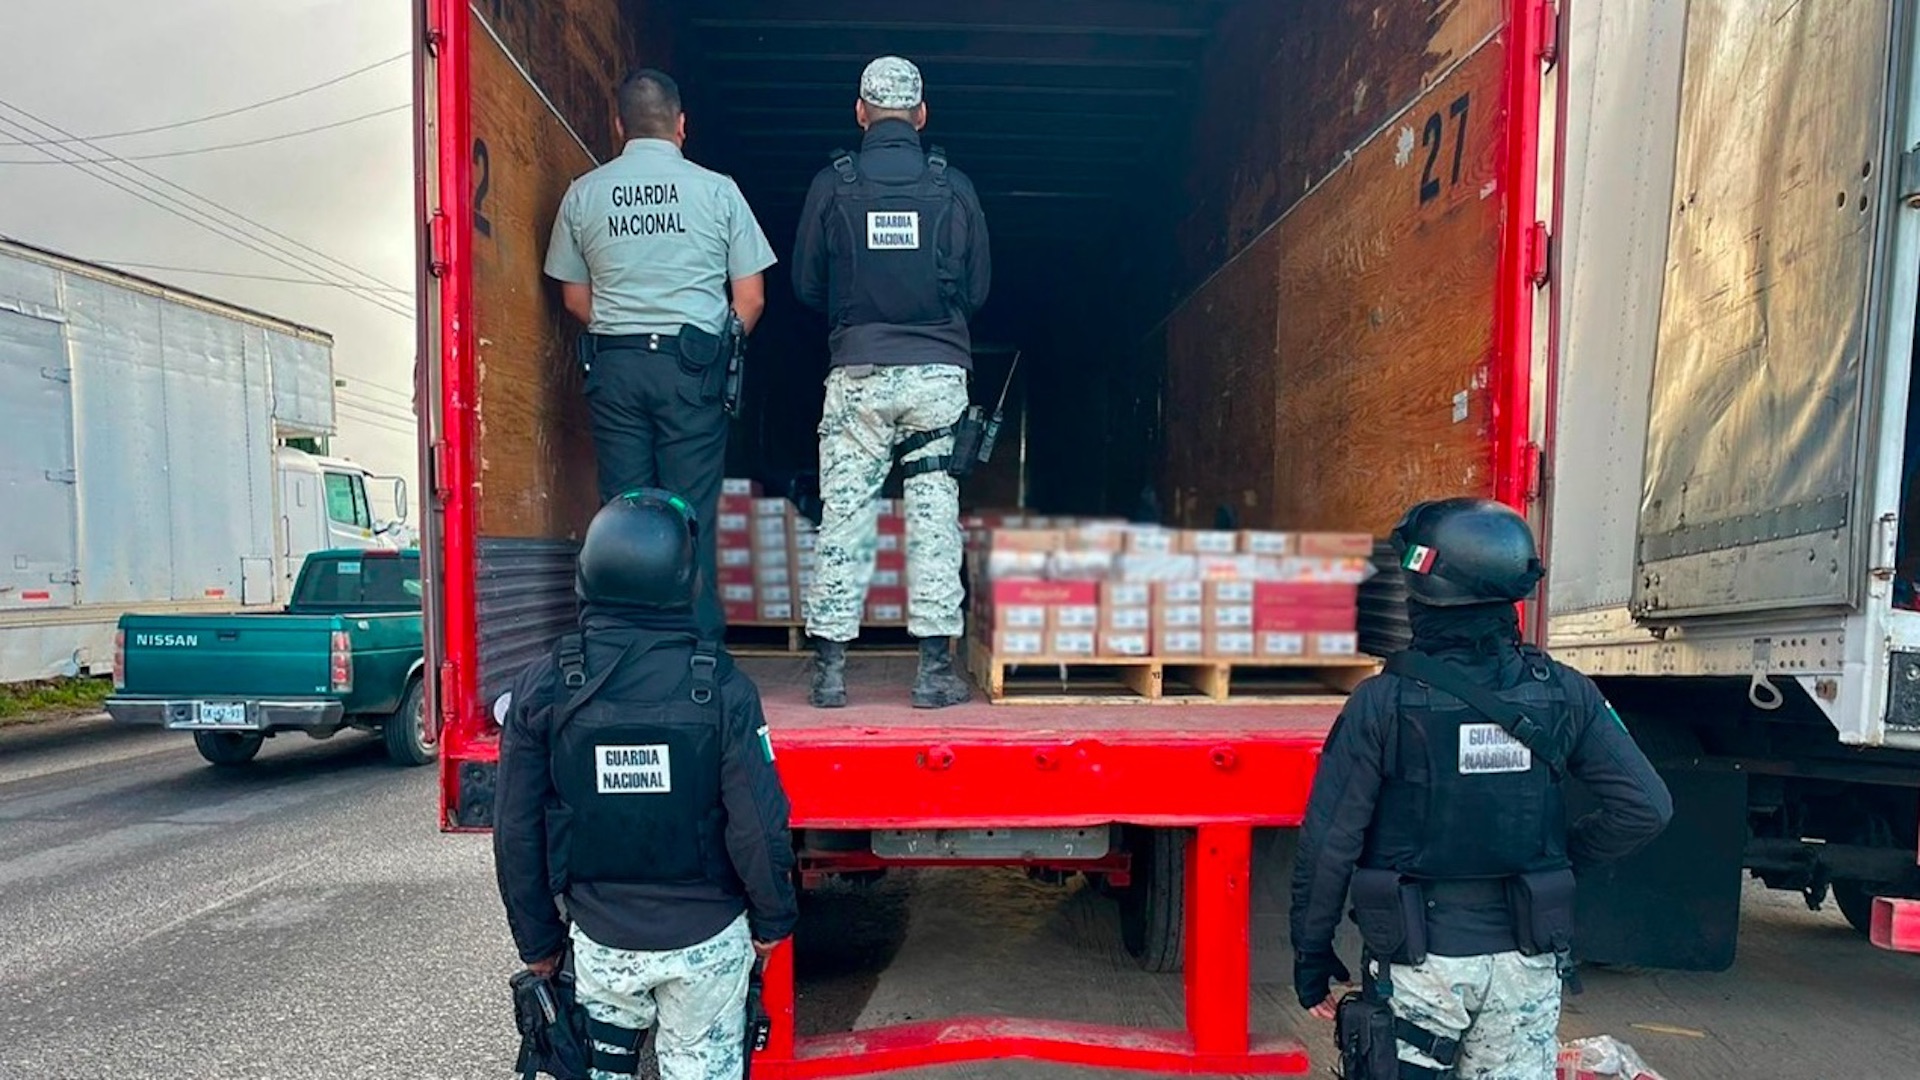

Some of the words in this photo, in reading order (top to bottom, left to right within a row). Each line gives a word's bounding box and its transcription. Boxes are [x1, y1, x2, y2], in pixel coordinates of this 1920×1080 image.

[1420, 91, 1470, 205] 27
[473, 137, 490, 239] 2
[612, 183, 679, 207] GUARDIA
[608, 212, 686, 237] NACIONAL
[875, 214, 912, 228] GUARDIA
[872, 232, 915, 246] NACIONAL
[136, 634, 198, 647] NISSAN
[605, 749, 660, 766] GUARDIA
[1464, 750, 1526, 770] NACIONAL
[603, 772, 665, 789] NACIONAL
